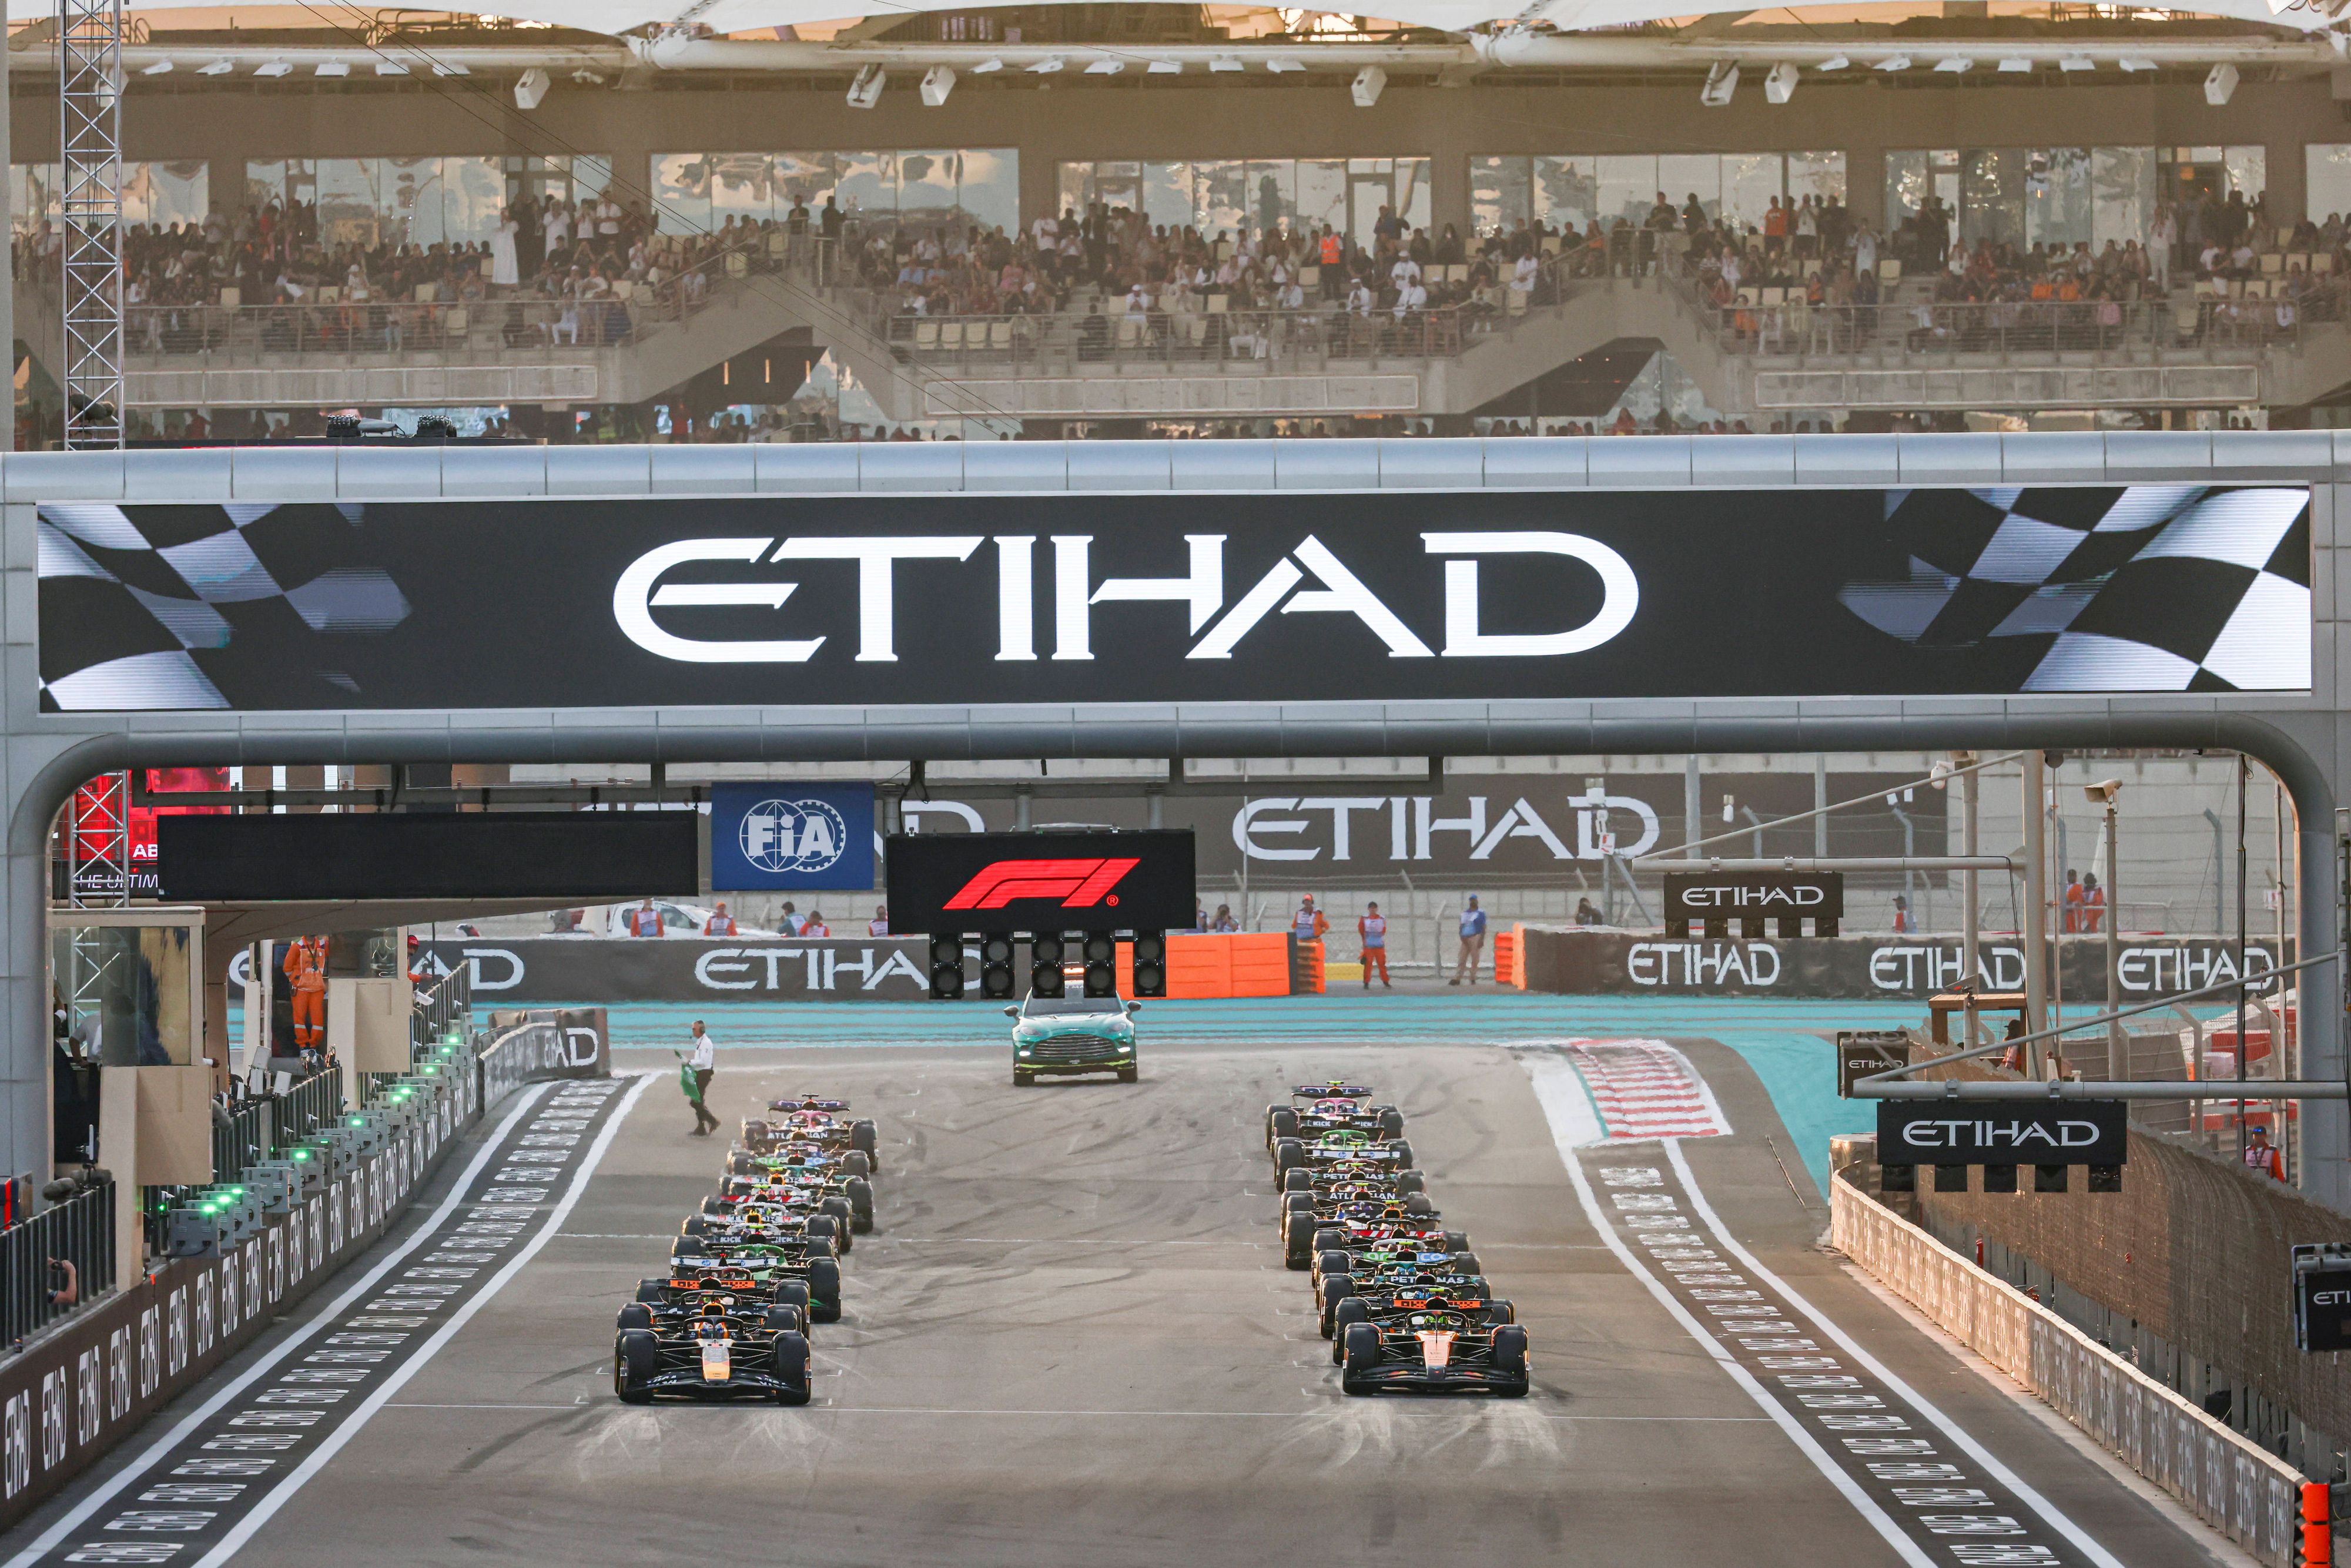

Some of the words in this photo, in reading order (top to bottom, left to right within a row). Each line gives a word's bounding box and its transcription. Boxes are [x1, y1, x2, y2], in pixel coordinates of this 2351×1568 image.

[612, 532, 1640, 663] ETIHAD
[1233, 796, 1660, 861] ETIHAD
[1682, 886, 1824, 906] ETIHAD
[1627, 943, 1781, 986] ETIHAD
[2117, 947, 2275, 991] ETIHAD
[1903, 1121, 2100, 1147] ETIHAD
